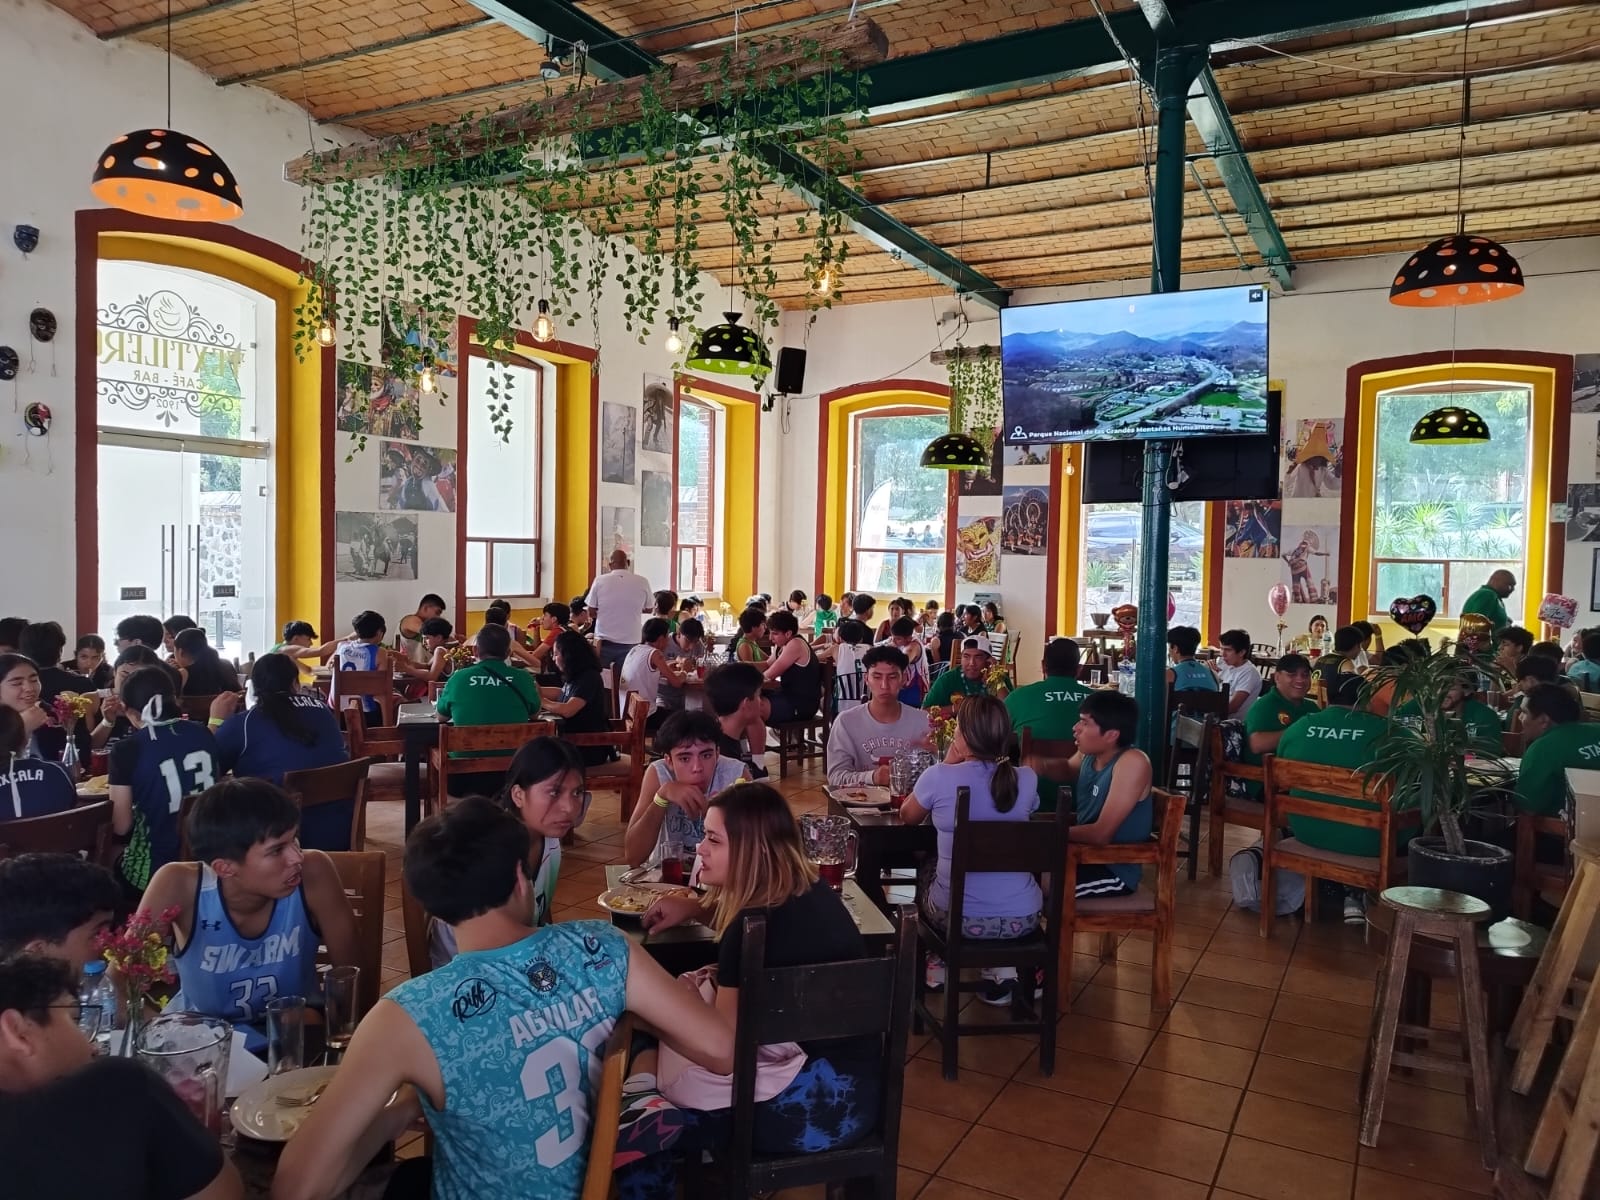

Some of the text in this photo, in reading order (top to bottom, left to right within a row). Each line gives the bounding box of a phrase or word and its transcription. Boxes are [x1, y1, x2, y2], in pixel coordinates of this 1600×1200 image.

[1029, 431, 1052, 439] Parque
[1053, 429, 1084, 437] Nacional
[1106, 426, 1134, 434] Grandes
[1136, 424, 1171, 433] Montañas
[122, 590, 145, 598] JALE
[215, 586, 234, 595] JALE
[1306, 726, 1366, 741] STAFF
[159, 750, 215, 815] 13
[200, 926, 300, 974] SWARM
